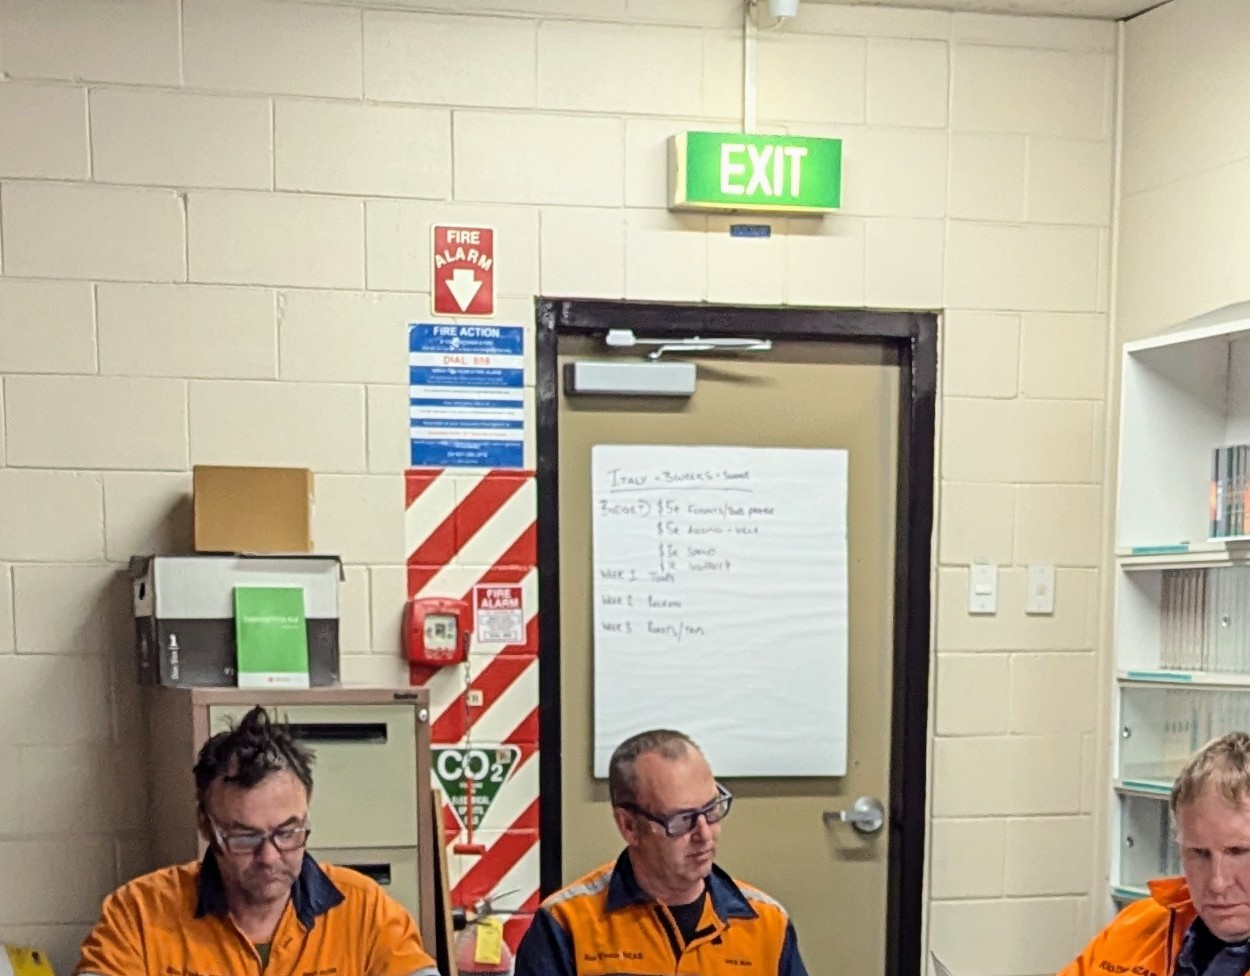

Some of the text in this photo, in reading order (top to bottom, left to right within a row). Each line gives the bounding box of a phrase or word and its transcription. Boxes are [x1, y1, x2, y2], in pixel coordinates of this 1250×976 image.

[719, 144, 808, 197] EXIT
[447, 229, 480, 245] FIRE
[435, 246, 492, 271] ALARM
[433, 326, 500, 338] FIRE ACTION
[443, 356, 466, 365] DIAL
[608, 468, 647, 487] ITALY
[486, 589, 511, 599] FIRE
[481, 597, 519, 609] ALARM
[437, 750, 504, 782] CO2
